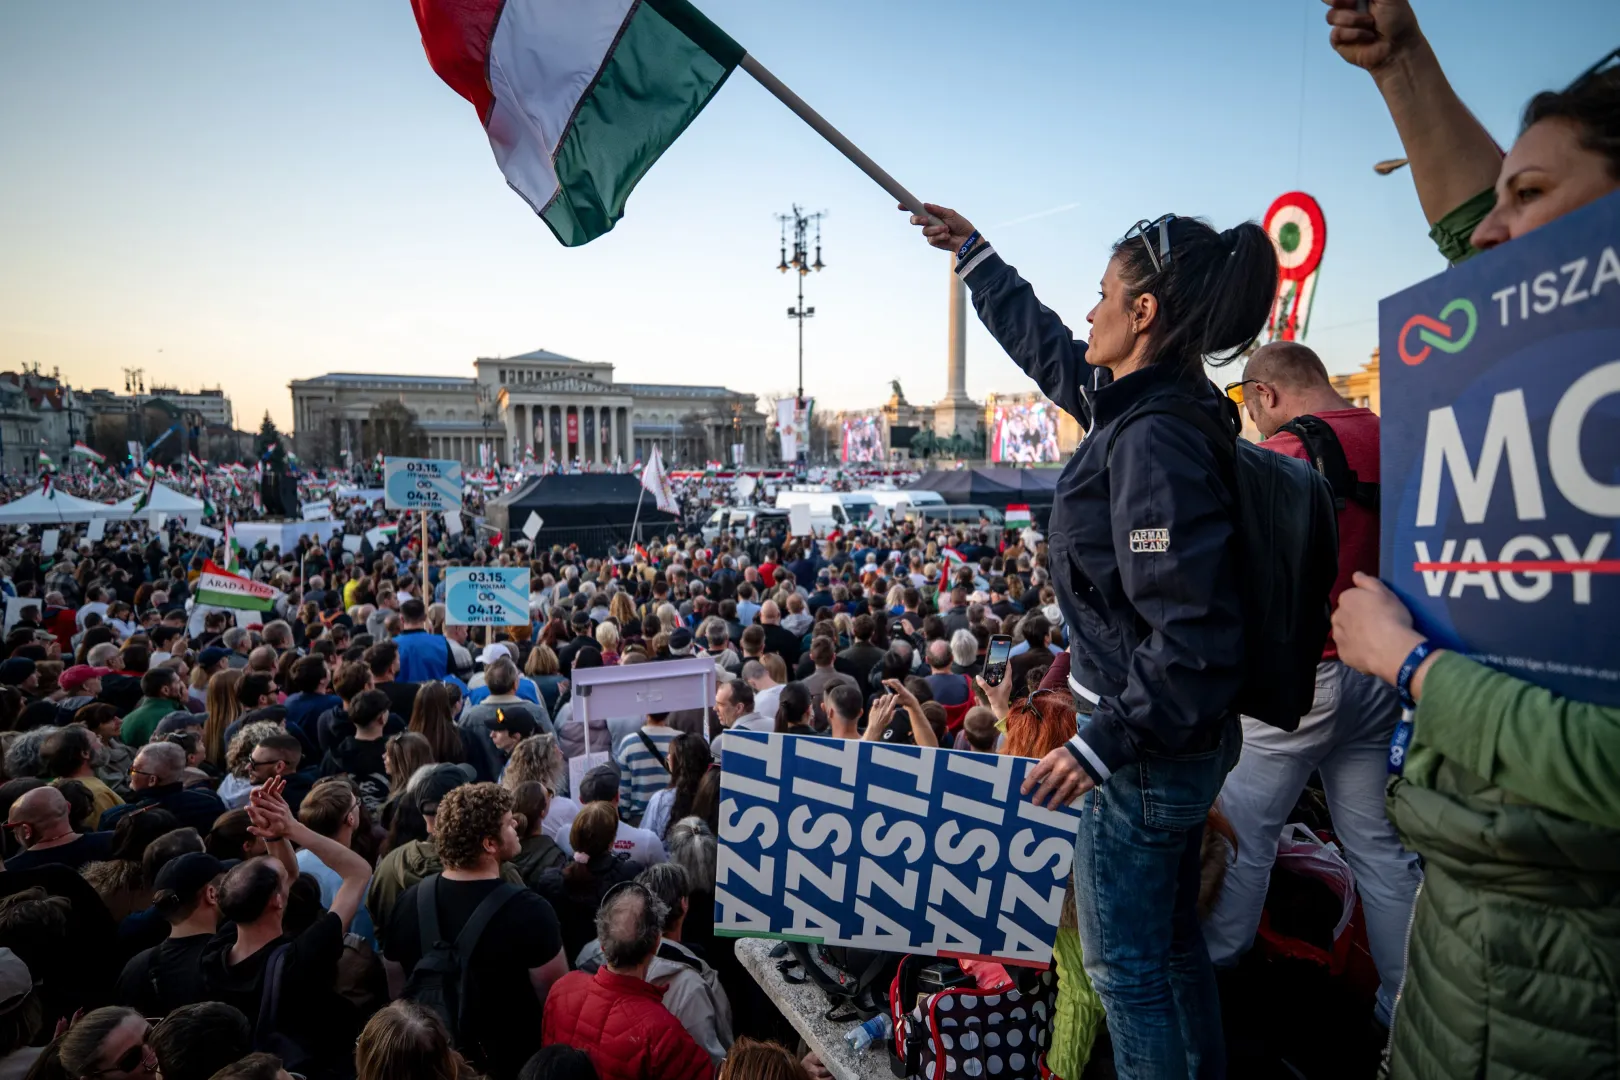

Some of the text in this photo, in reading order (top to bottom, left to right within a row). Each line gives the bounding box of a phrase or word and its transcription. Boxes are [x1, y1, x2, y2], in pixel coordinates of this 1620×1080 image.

[1492, 246, 1620, 326] TISZA
[407, 462, 441, 473] 03.15.
[407, 491, 442, 501] 04.12.
[468, 572, 506, 582] 03.15.
[1414, 533, 1611, 604] VAGY
[467, 604, 506, 615] 04.12.
[714, 731, 784, 932] TISZA
[782, 738, 862, 940] TISZA
[851, 745, 937, 946] TISZA
[921, 752, 1015, 955] TISZA
